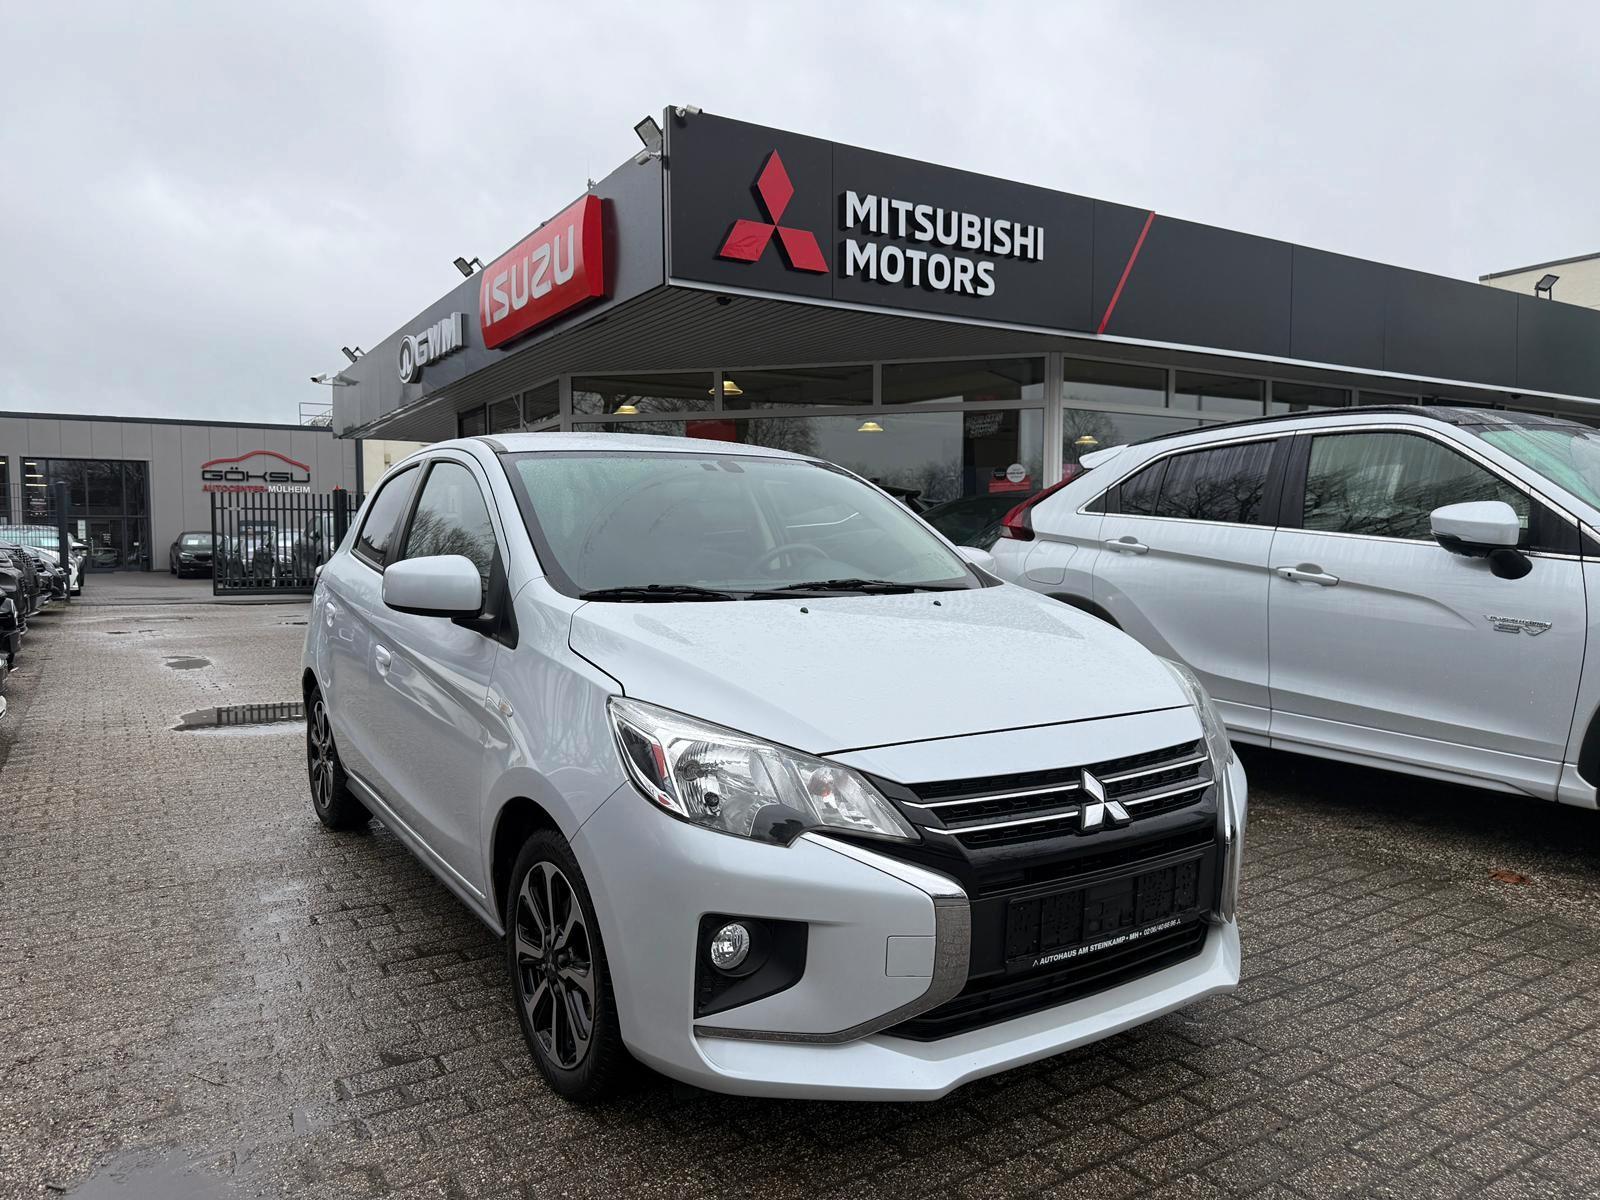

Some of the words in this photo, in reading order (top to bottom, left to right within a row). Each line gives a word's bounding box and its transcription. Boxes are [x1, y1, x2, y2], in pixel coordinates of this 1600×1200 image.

[845, 190, 1044, 262] MITSUBISHI
[485, 224, 575, 327] ISUZU
[845, 239, 995, 297] MOTORS
[414, 312, 464, 367] GWM
[201, 466, 311, 483] GÖKSU
[1039, 949, 1077, 965] AUTOHAUS
[1077, 945, 1089, 956] AM
[1089, 936, 1126, 952] STEINKAMP
